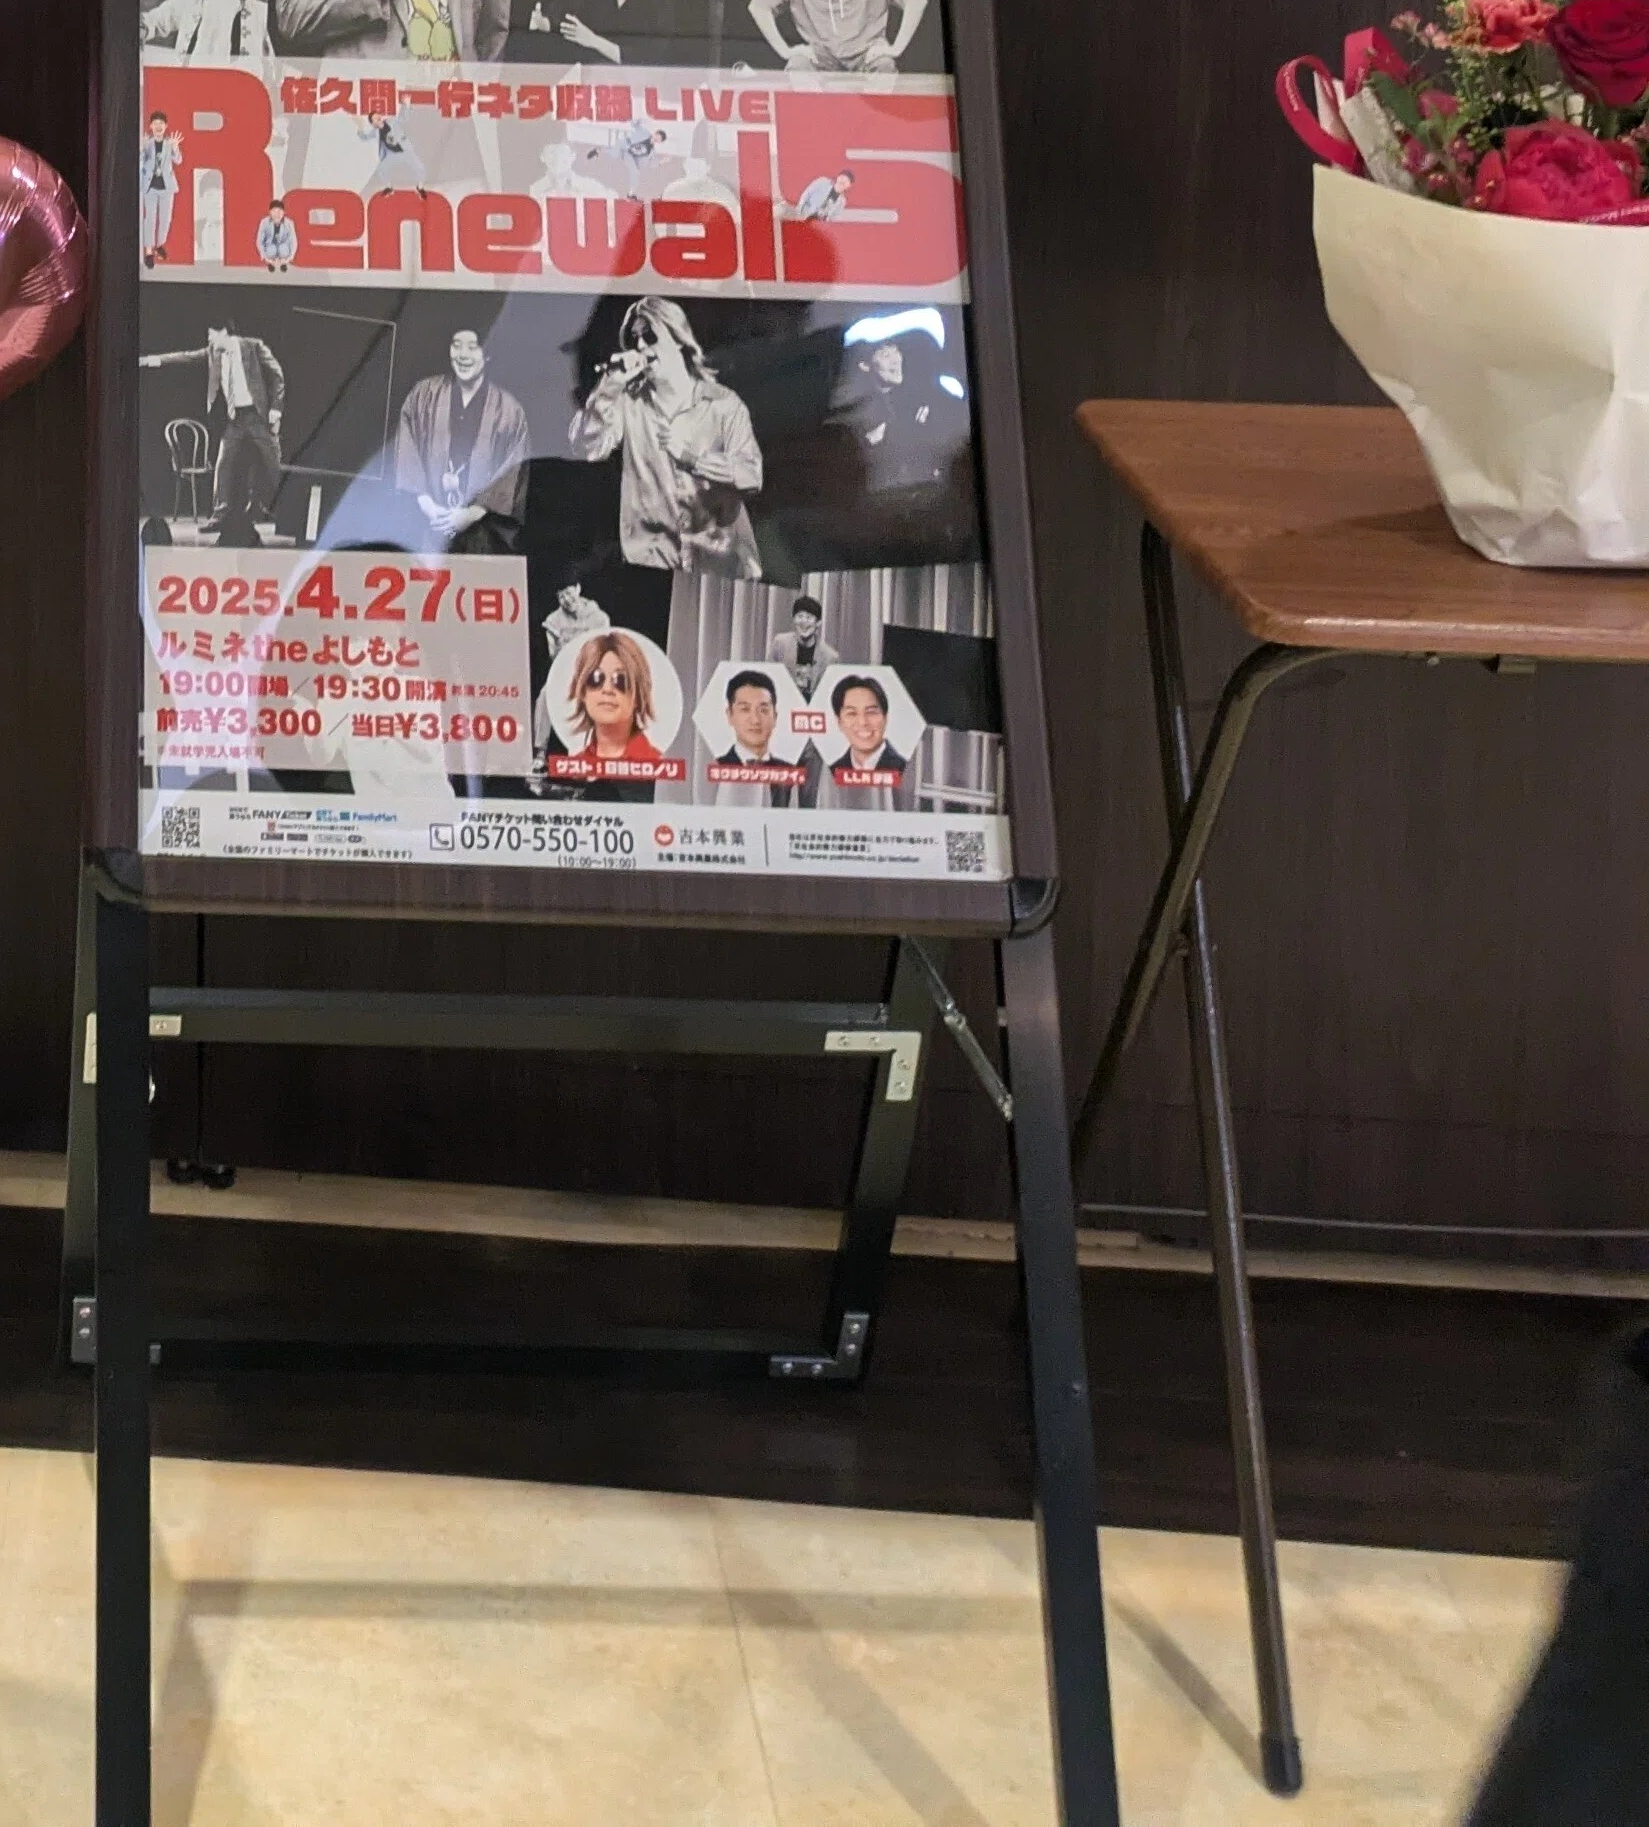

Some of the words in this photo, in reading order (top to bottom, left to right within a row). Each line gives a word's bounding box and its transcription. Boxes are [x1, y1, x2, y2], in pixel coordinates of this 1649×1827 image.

[644, 86, 771, 123] LIVE
[156, 630, 421, 668] ルミネtheよしもと
[460, 825, 634, 854] 0570-550-100
